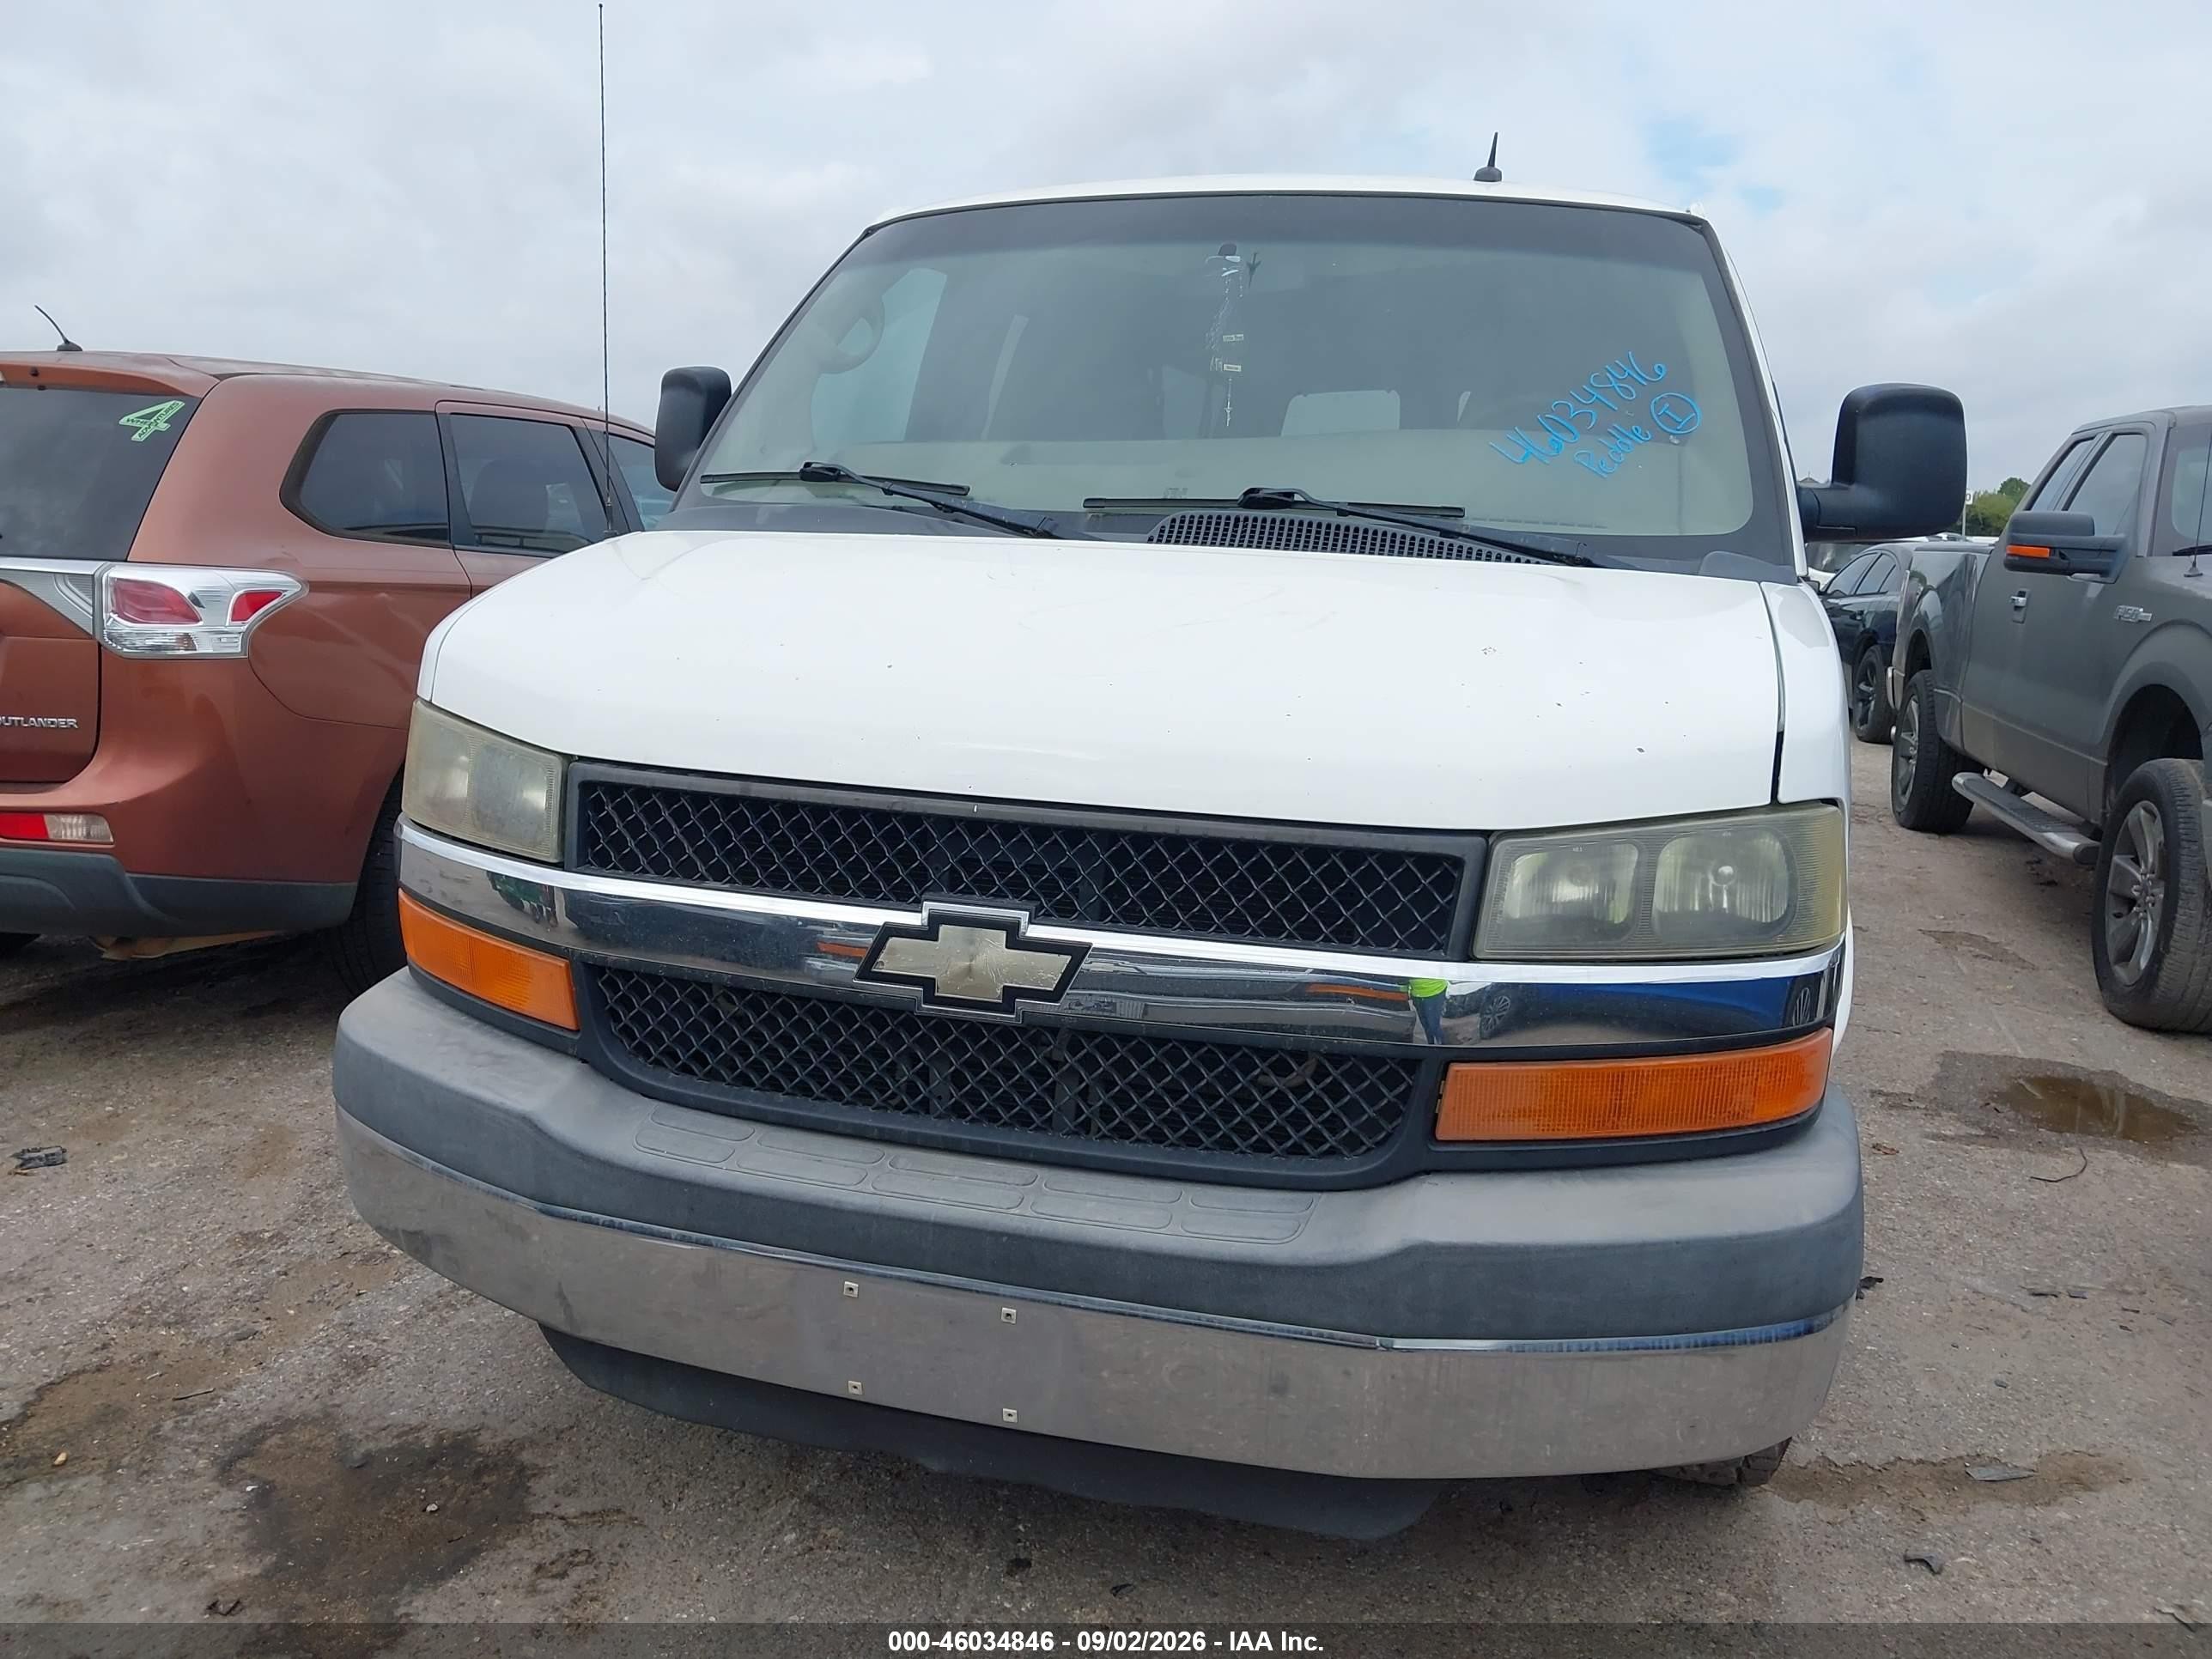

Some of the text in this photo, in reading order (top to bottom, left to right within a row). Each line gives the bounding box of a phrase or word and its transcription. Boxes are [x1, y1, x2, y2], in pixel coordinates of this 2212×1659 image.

[1489, 350, 1668, 465] 46034846
[1573, 422, 1652, 478] Peddle
[0, 715, 78, 729] UTLANDER
